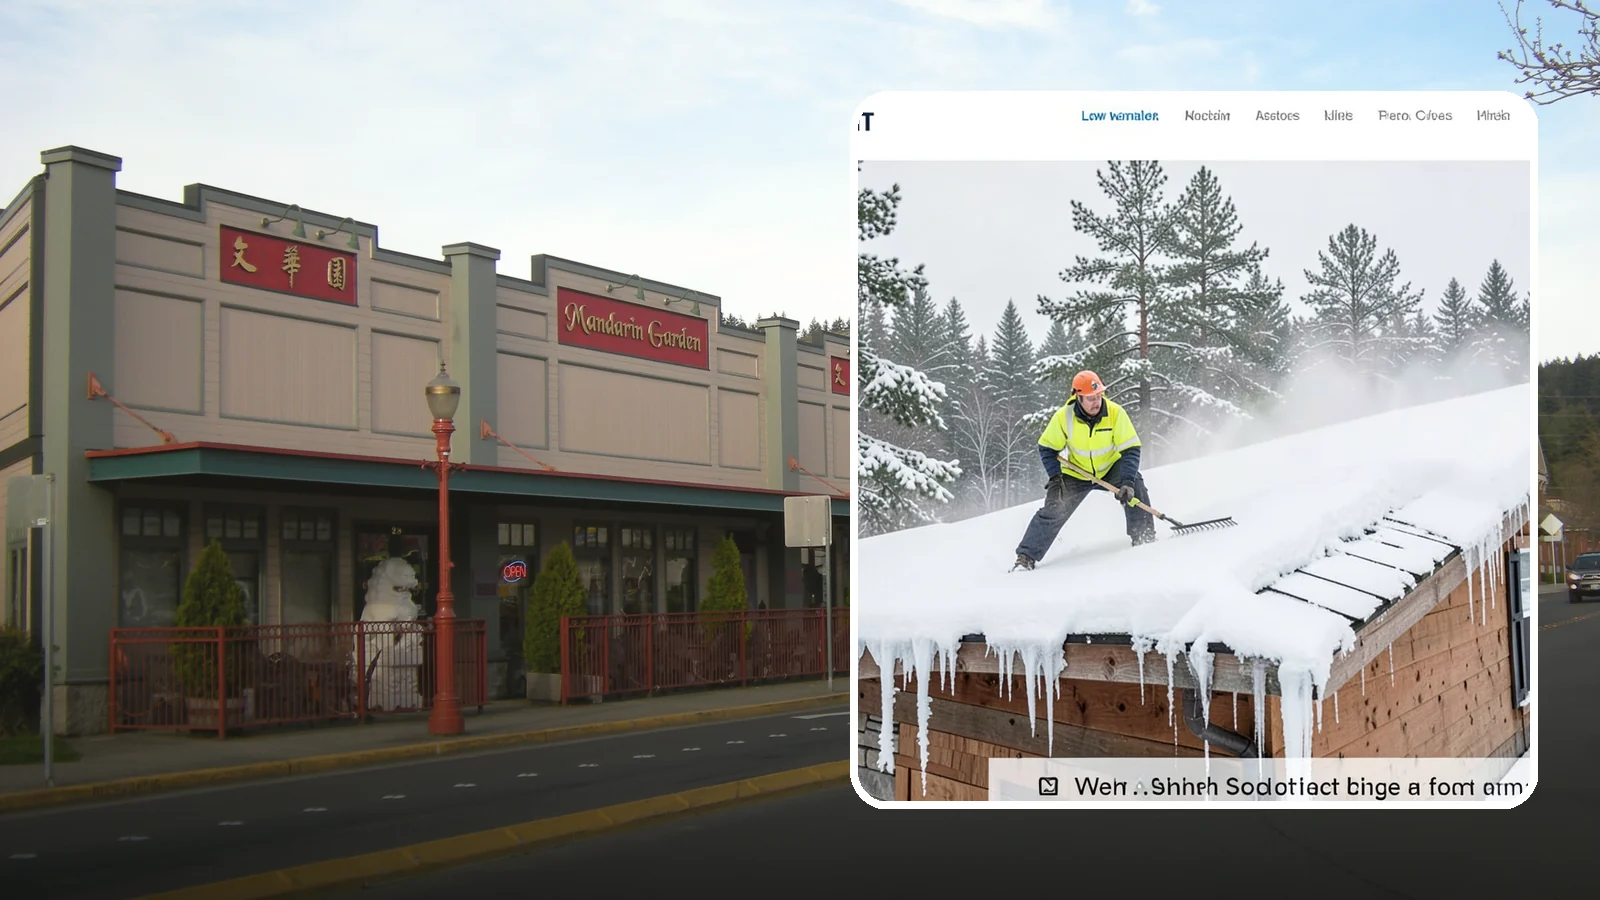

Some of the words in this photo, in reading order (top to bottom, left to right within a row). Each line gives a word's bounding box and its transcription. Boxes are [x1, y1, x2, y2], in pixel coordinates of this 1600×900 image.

[564, 302, 644, 341] Mandarin
[647, 320, 701, 352] Garden
[503, 565, 527, 578] OPEN
